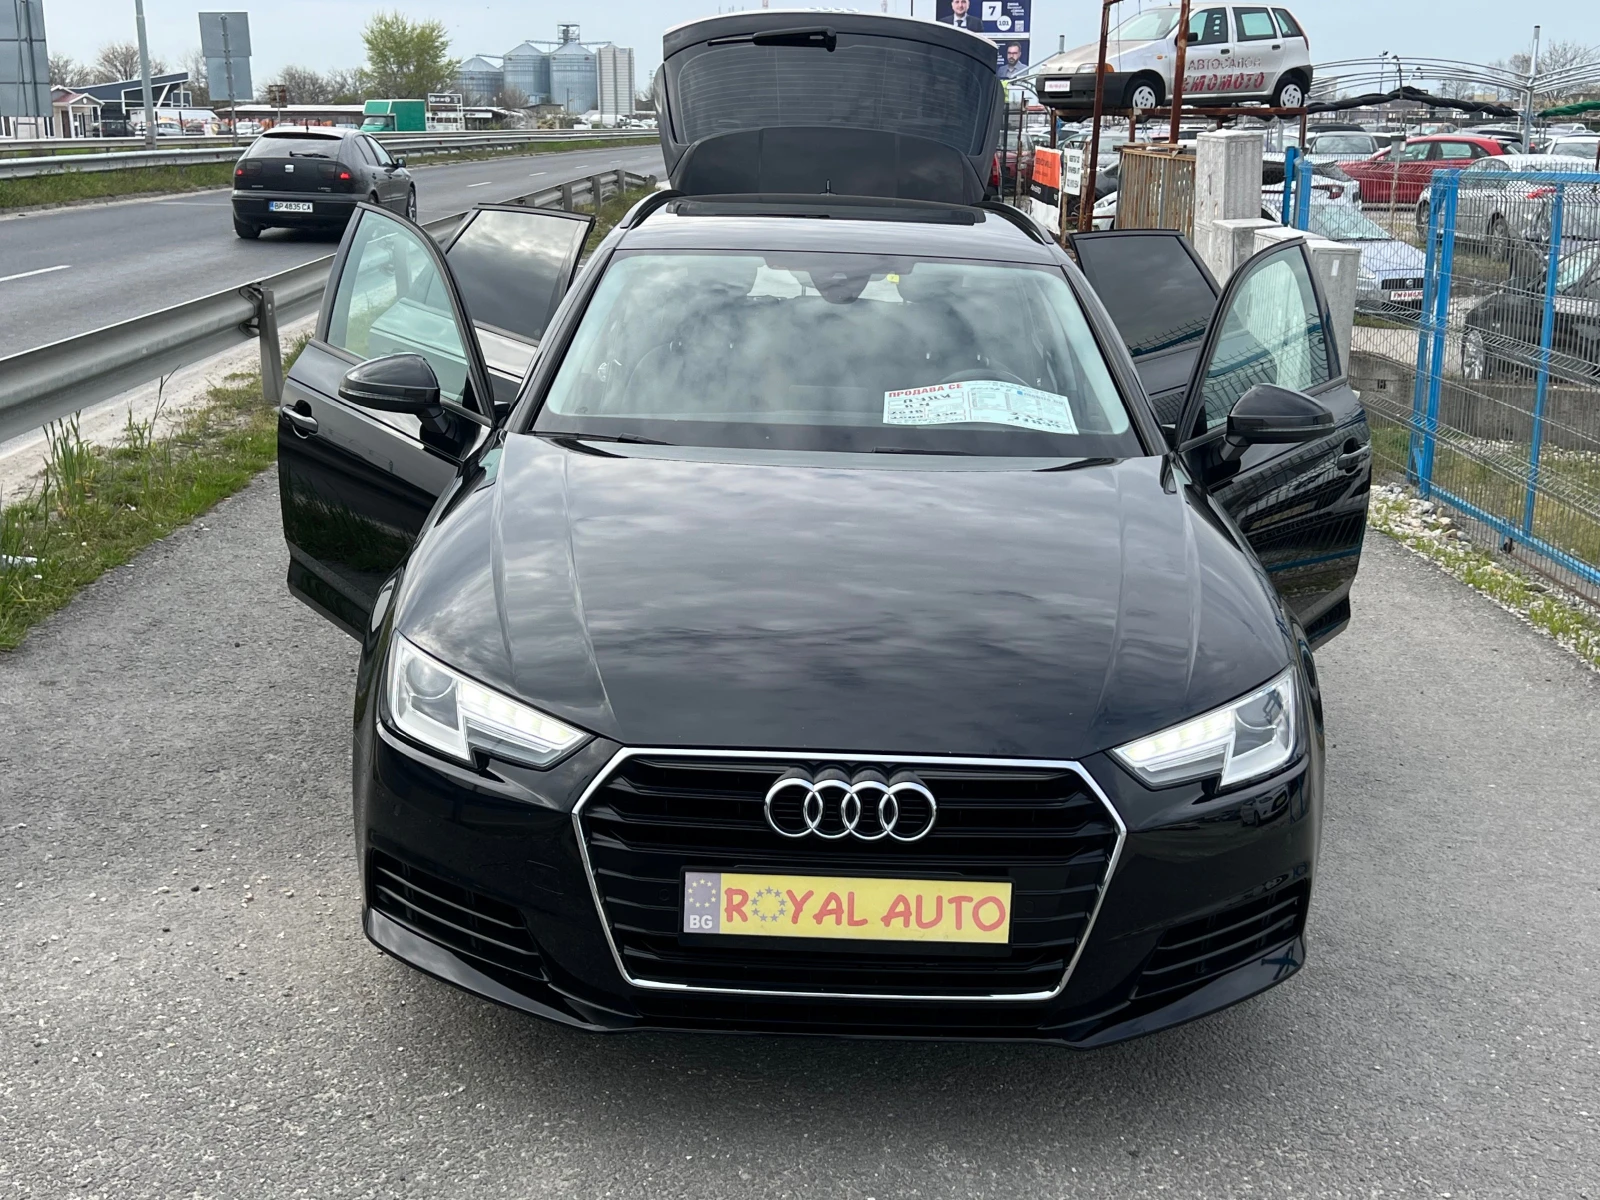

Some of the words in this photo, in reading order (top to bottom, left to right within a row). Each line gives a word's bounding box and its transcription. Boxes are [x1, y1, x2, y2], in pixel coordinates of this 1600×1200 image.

[988, 6, 996, 16] 7
[888, 386, 945, 398] ПРОДАВА
[880, 893, 1006, 932] AUTO
[689, 914, 713, 929] BG
